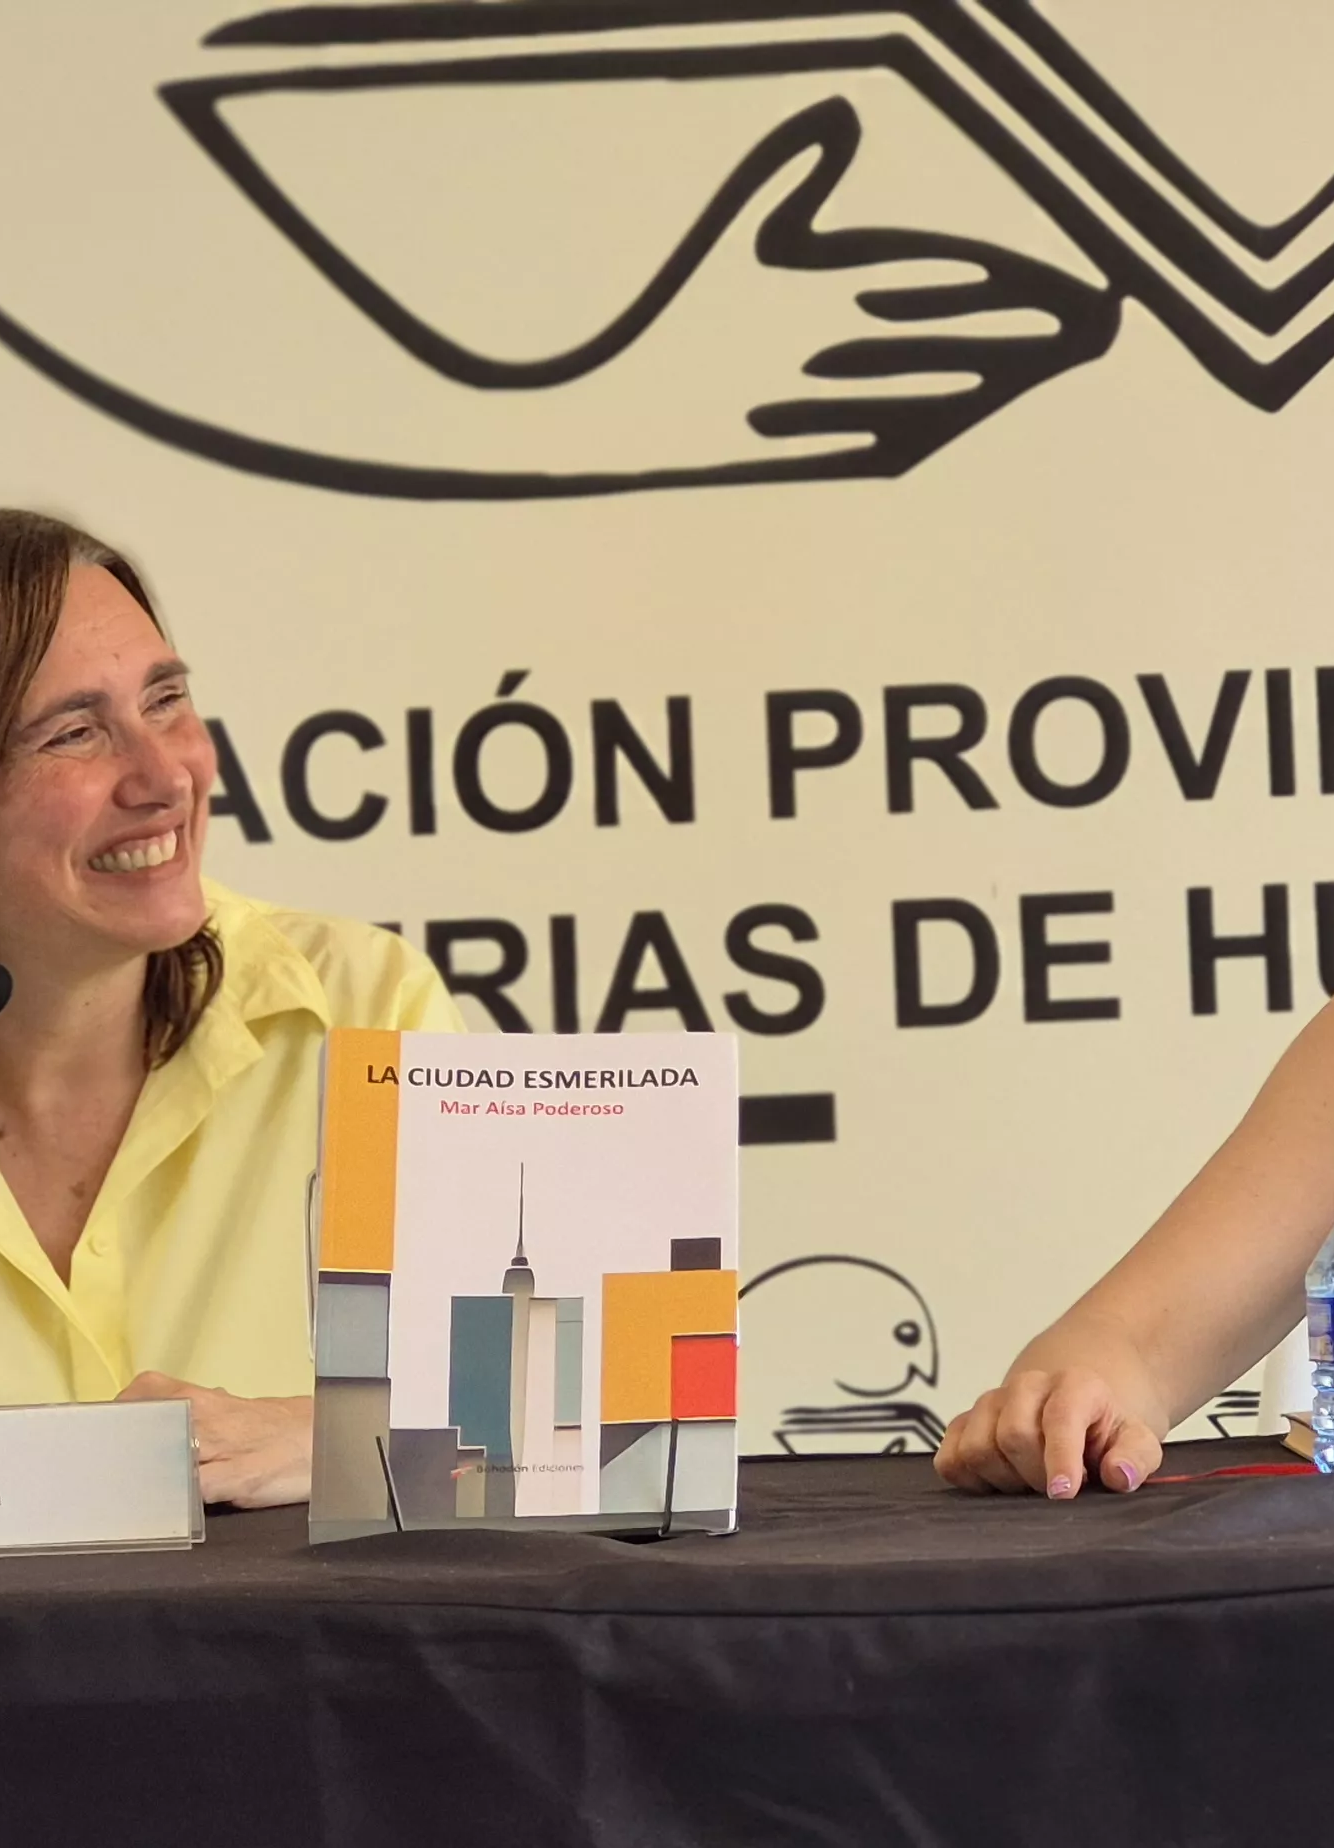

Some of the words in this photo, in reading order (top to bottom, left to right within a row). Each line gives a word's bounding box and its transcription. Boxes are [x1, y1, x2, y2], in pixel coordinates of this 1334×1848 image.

[892, 891, 1120, 1029] DE
[366, 1065, 399, 1086] LA
[407, 1067, 515, 1089] CIUDAD
[523, 1067, 700, 1089] ESMERILADA
[440, 1099, 480, 1115] Mar
[485, 1099, 526, 1116] Aísa
[533, 1100, 625, 1117] Poderoso
